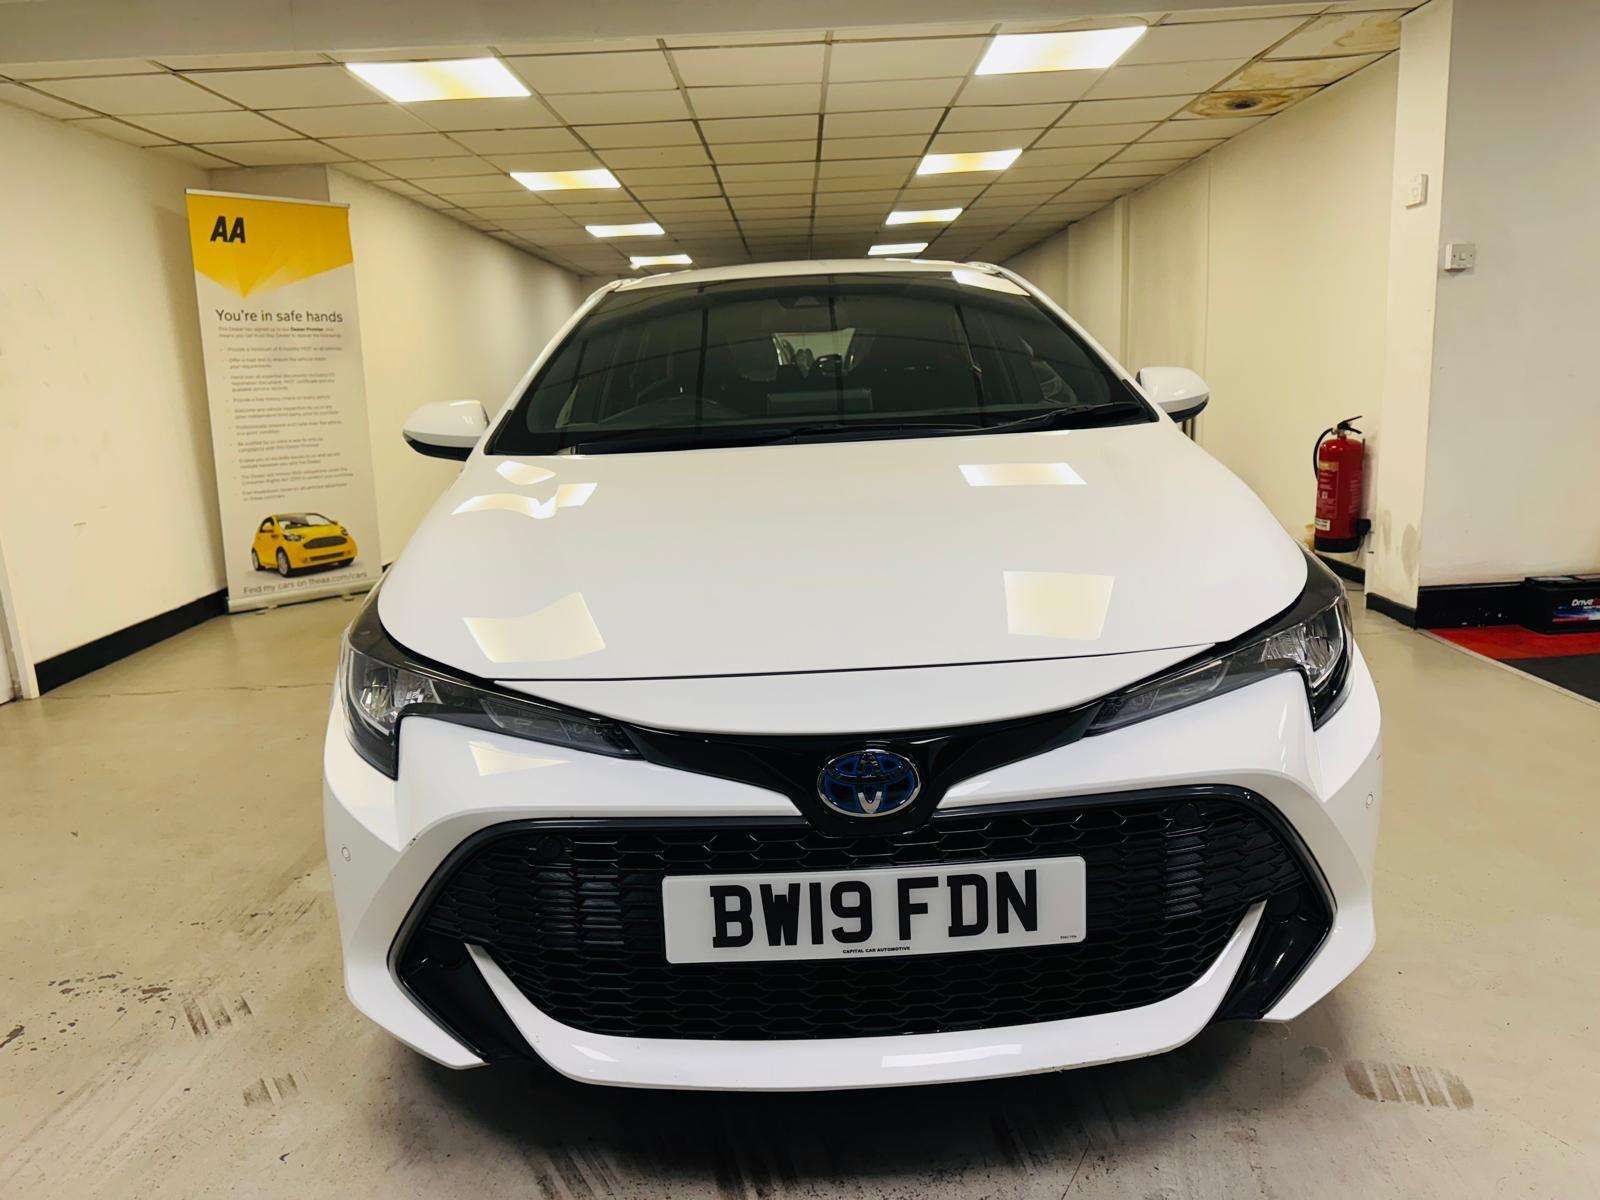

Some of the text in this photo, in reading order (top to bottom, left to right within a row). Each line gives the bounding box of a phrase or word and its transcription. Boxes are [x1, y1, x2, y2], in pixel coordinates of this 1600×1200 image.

[210, 215, 246, 243] AA
[215, 309, 344, 323] You're in safe hands
[709, 869, 1039, 949] BW19 FDN
